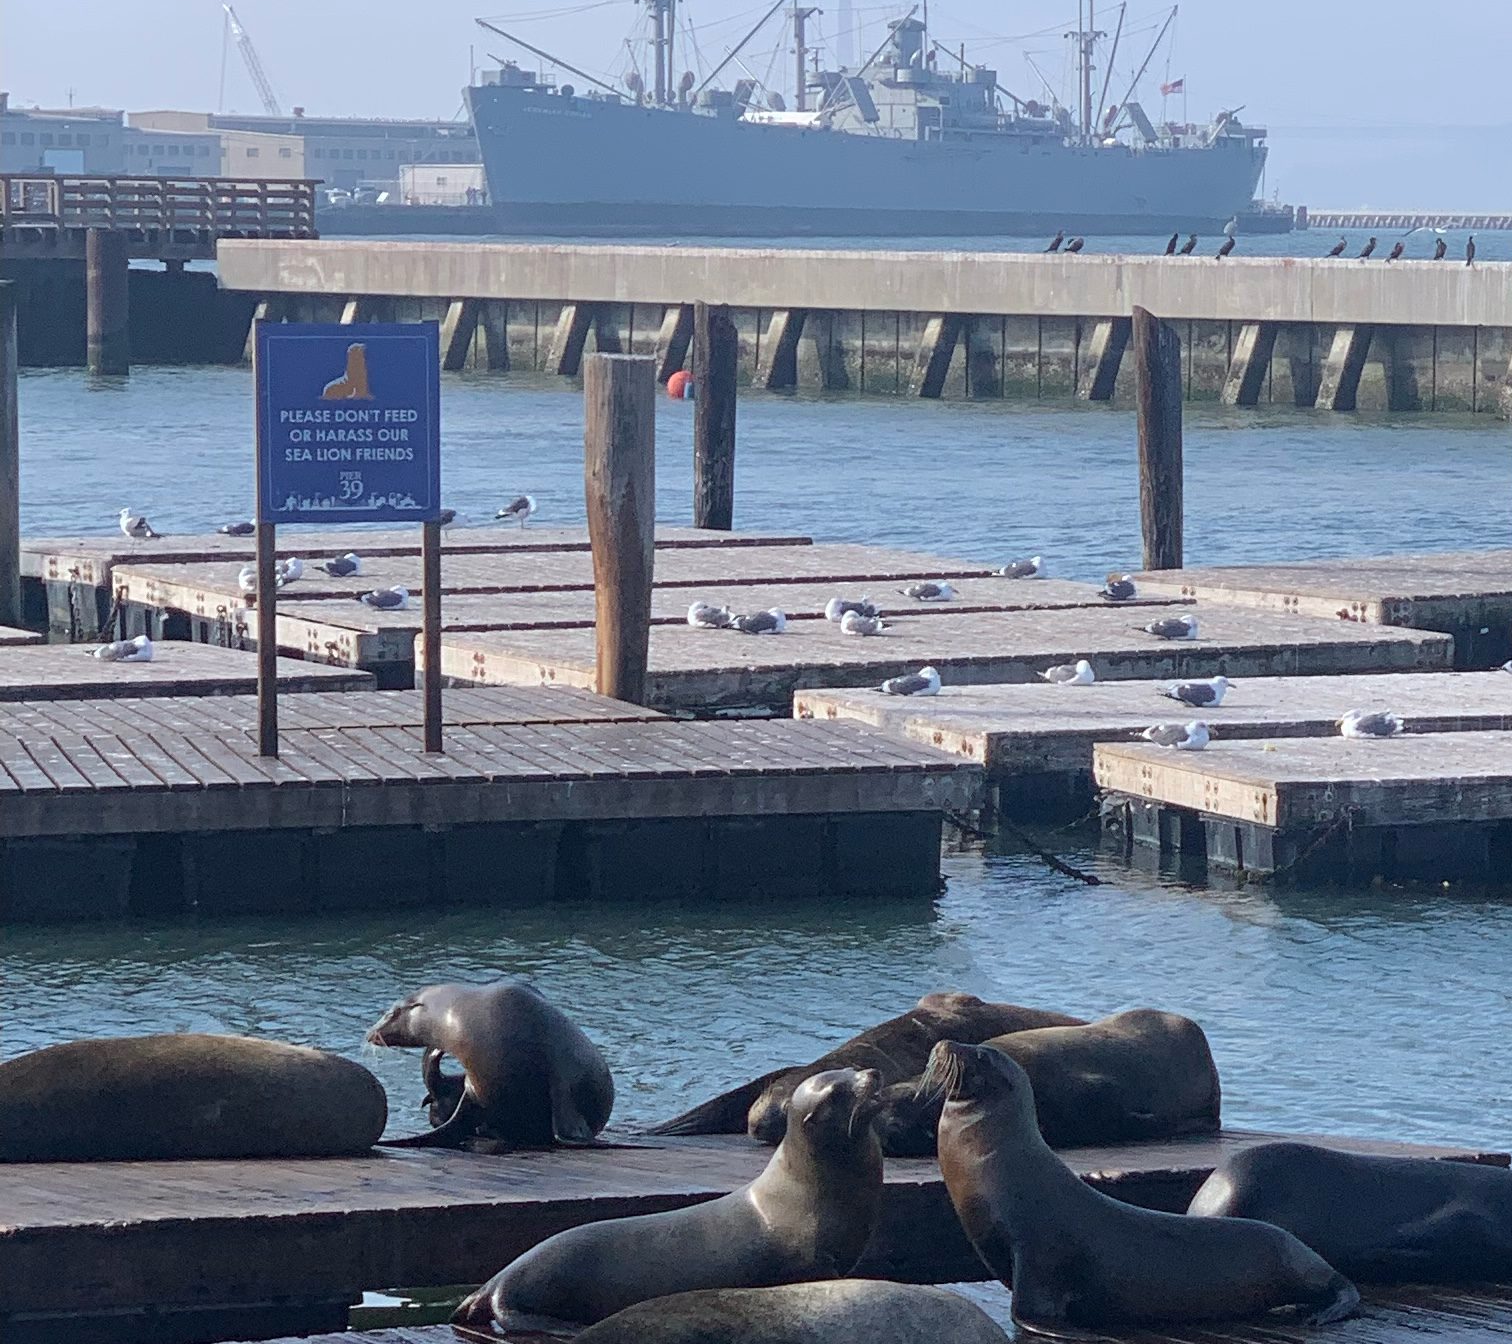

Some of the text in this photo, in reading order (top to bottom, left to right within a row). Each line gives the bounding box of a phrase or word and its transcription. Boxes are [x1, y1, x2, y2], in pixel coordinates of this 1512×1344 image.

[280, 409, 418, 423] PLEASE DON'T FEED
[289, 429, 409, 442] OR HARASS OUR
[285, 447, 414, 461] SEA LION FRIENDS
[339, 480, 364, 500] 39
